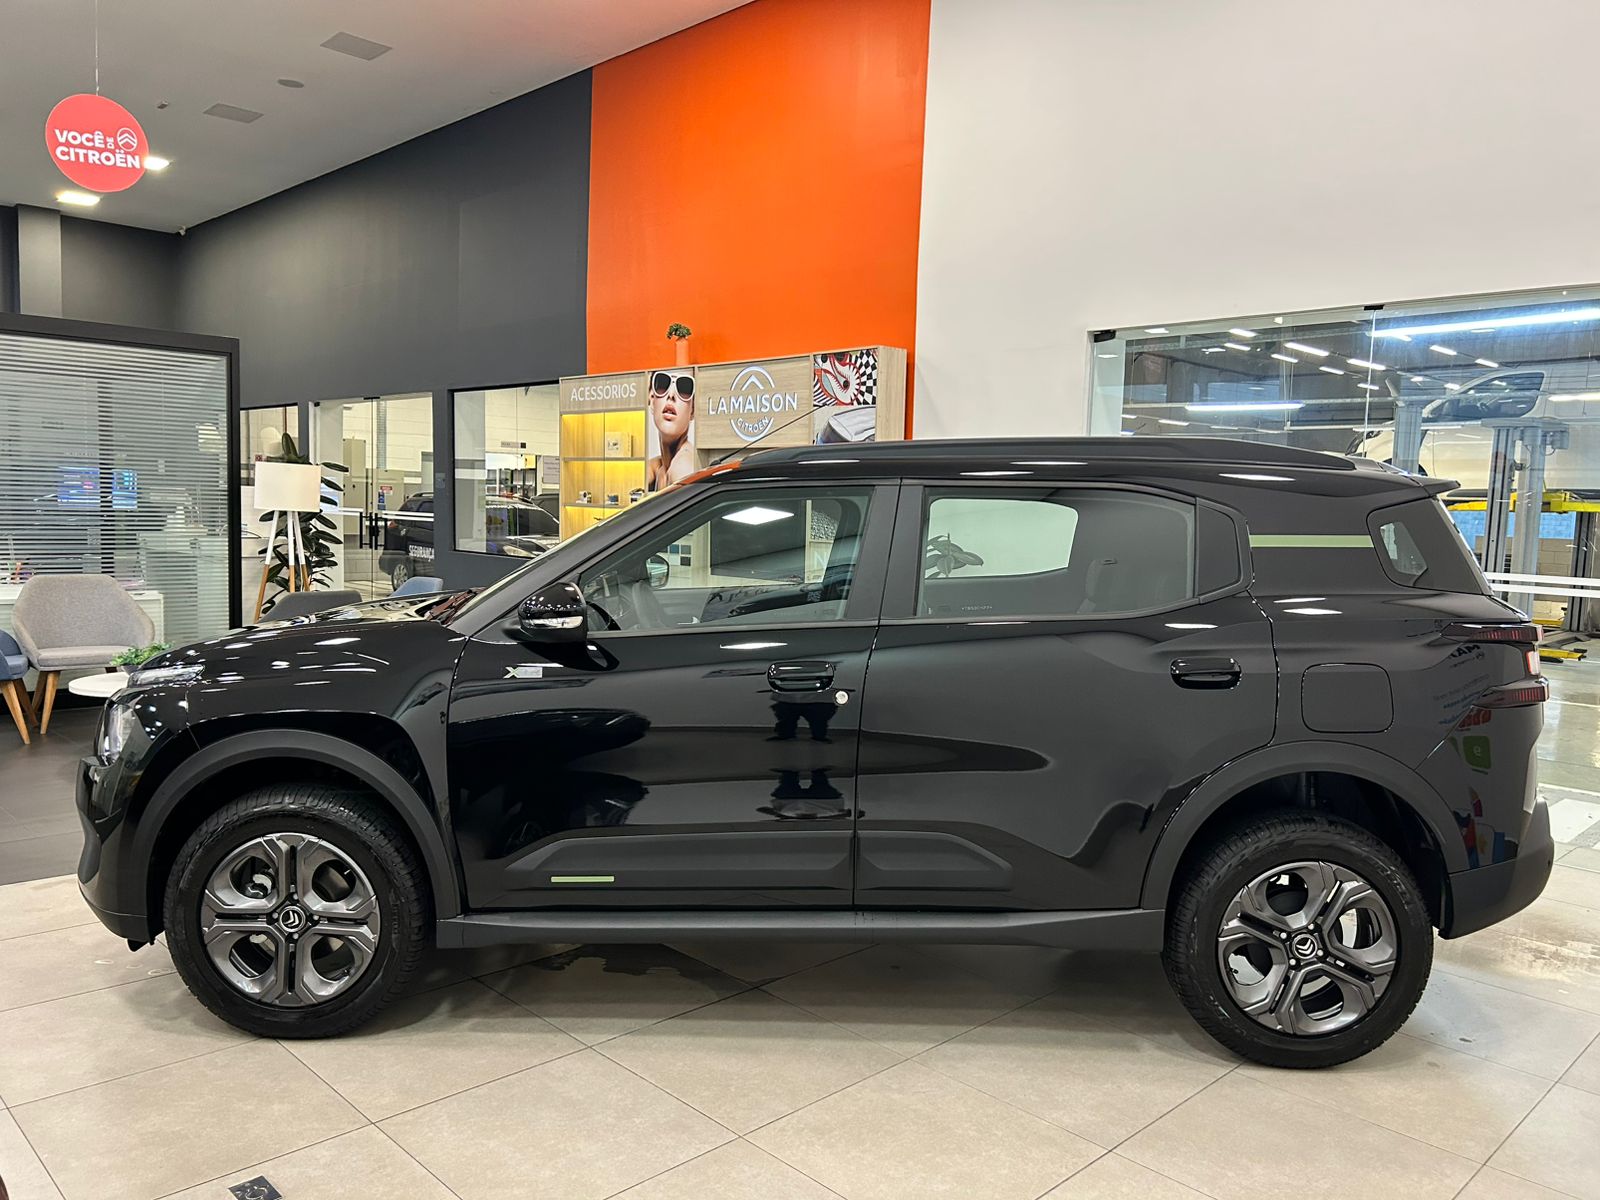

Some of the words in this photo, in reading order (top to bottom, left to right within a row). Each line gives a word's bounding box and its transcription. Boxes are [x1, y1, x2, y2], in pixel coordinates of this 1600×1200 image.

[54, 129, 105, 148] VOCÊ
[55, 146, 140, 168] CITROËN
[571, 381, 637, 401] ACESSÓRIOS
